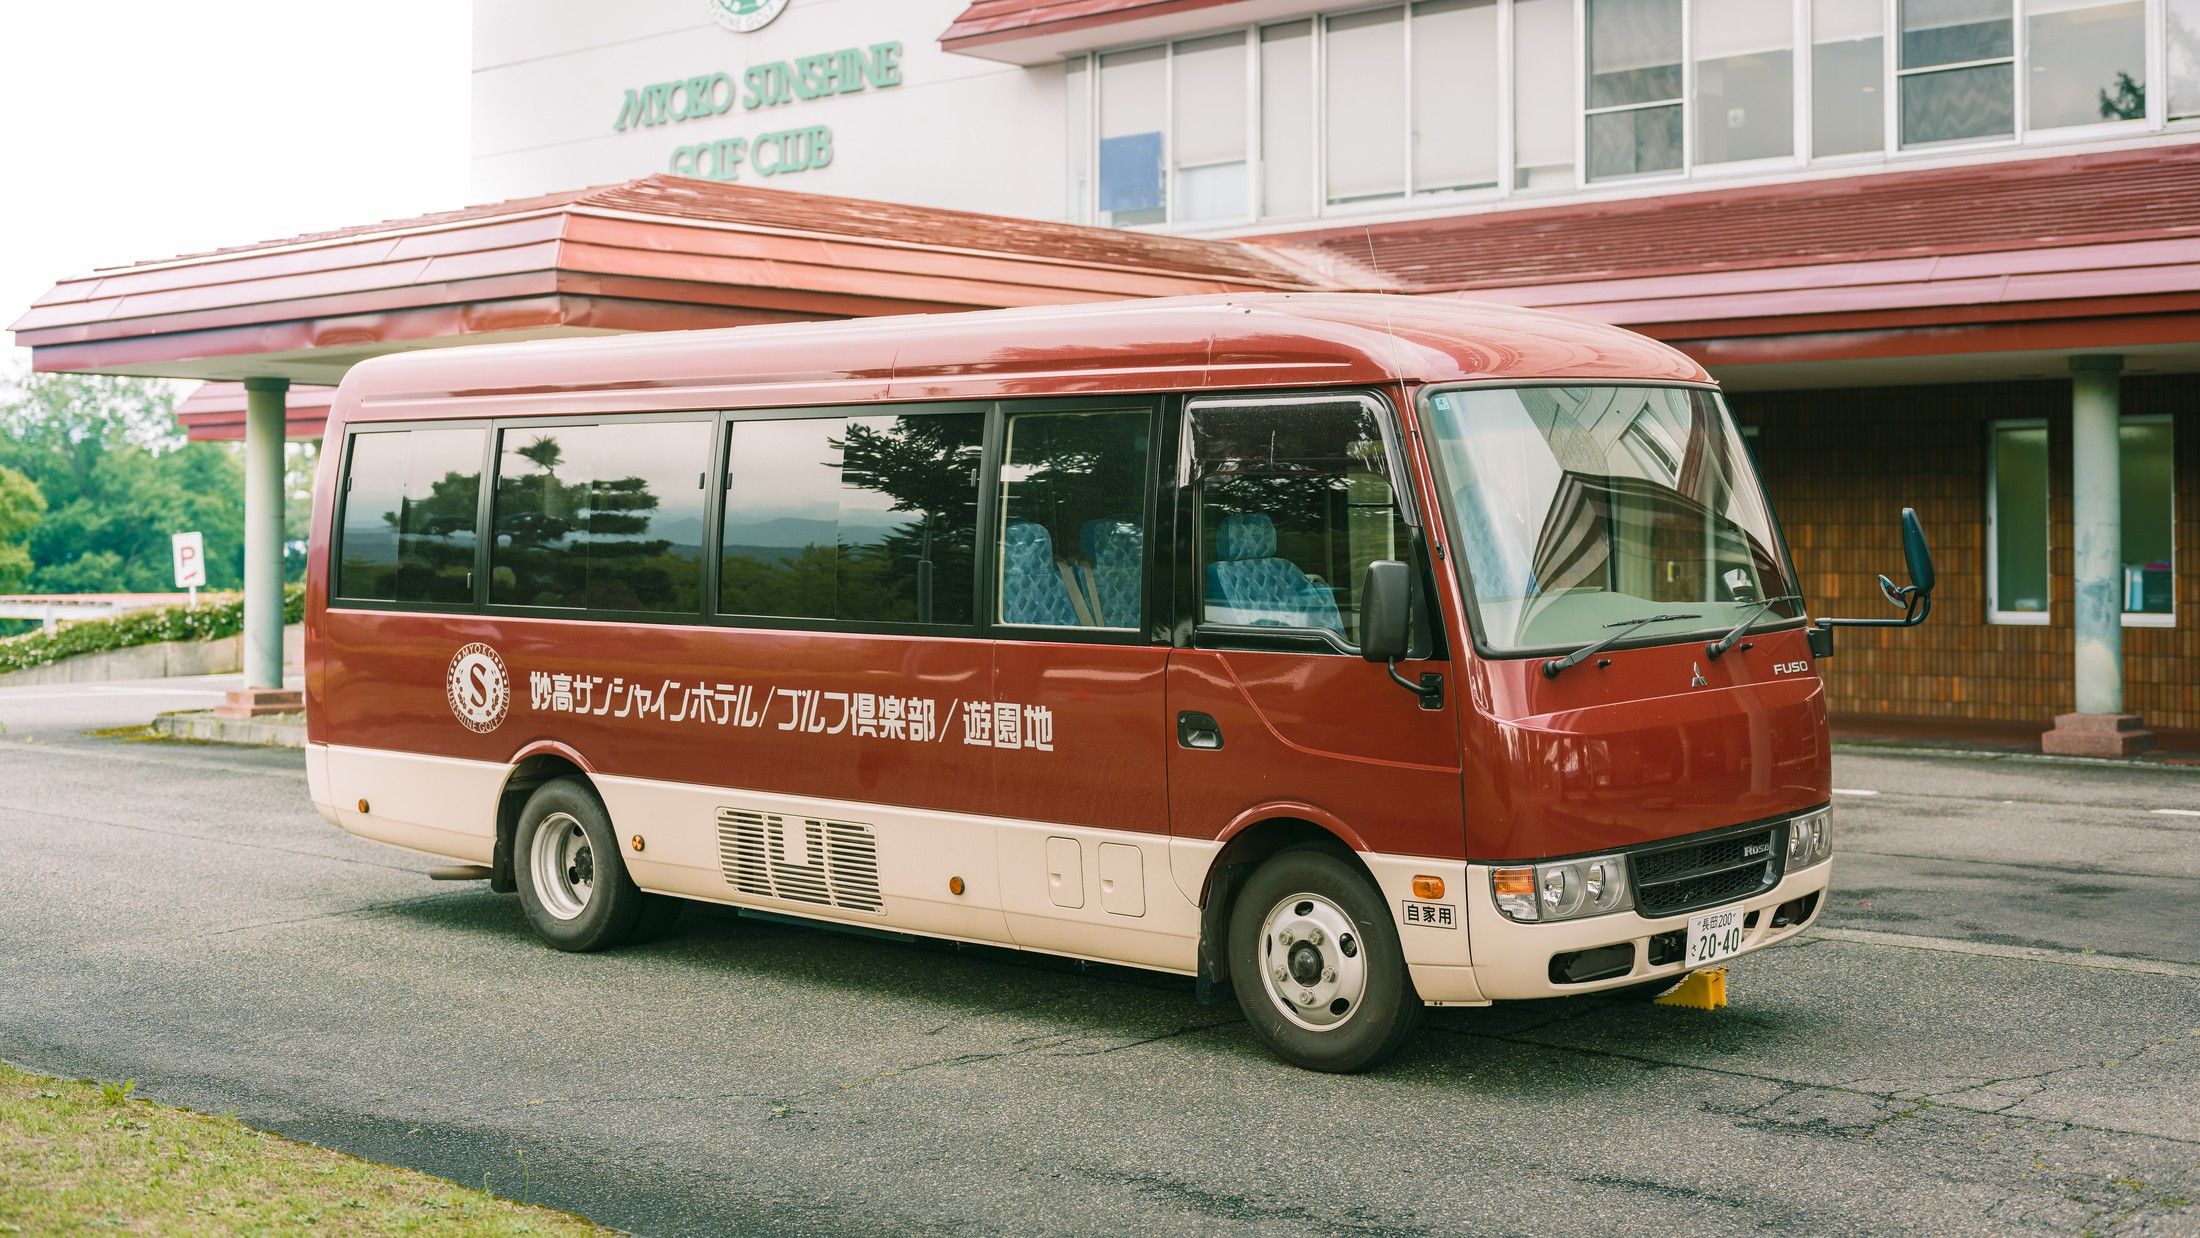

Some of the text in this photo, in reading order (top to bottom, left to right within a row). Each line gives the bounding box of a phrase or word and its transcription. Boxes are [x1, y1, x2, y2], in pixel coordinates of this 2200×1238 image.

[613, 41, 902, 131] MYOKO SUNSHINE
[670, 125, 833, 181] GOLF CLUB
[181, 546, 195, 568] P
[462, 644, 495, 659] MYOKO
[1773, 660, 1809, 675] FUSO
[447, 683, 510, 732] SUNSHINE GOLF CLUB
[1407, 904, 1452, 925] 自家用
[1702, 912, 1733, 932] 長岡200
[1698, 927, 1740, 961] 20-40
